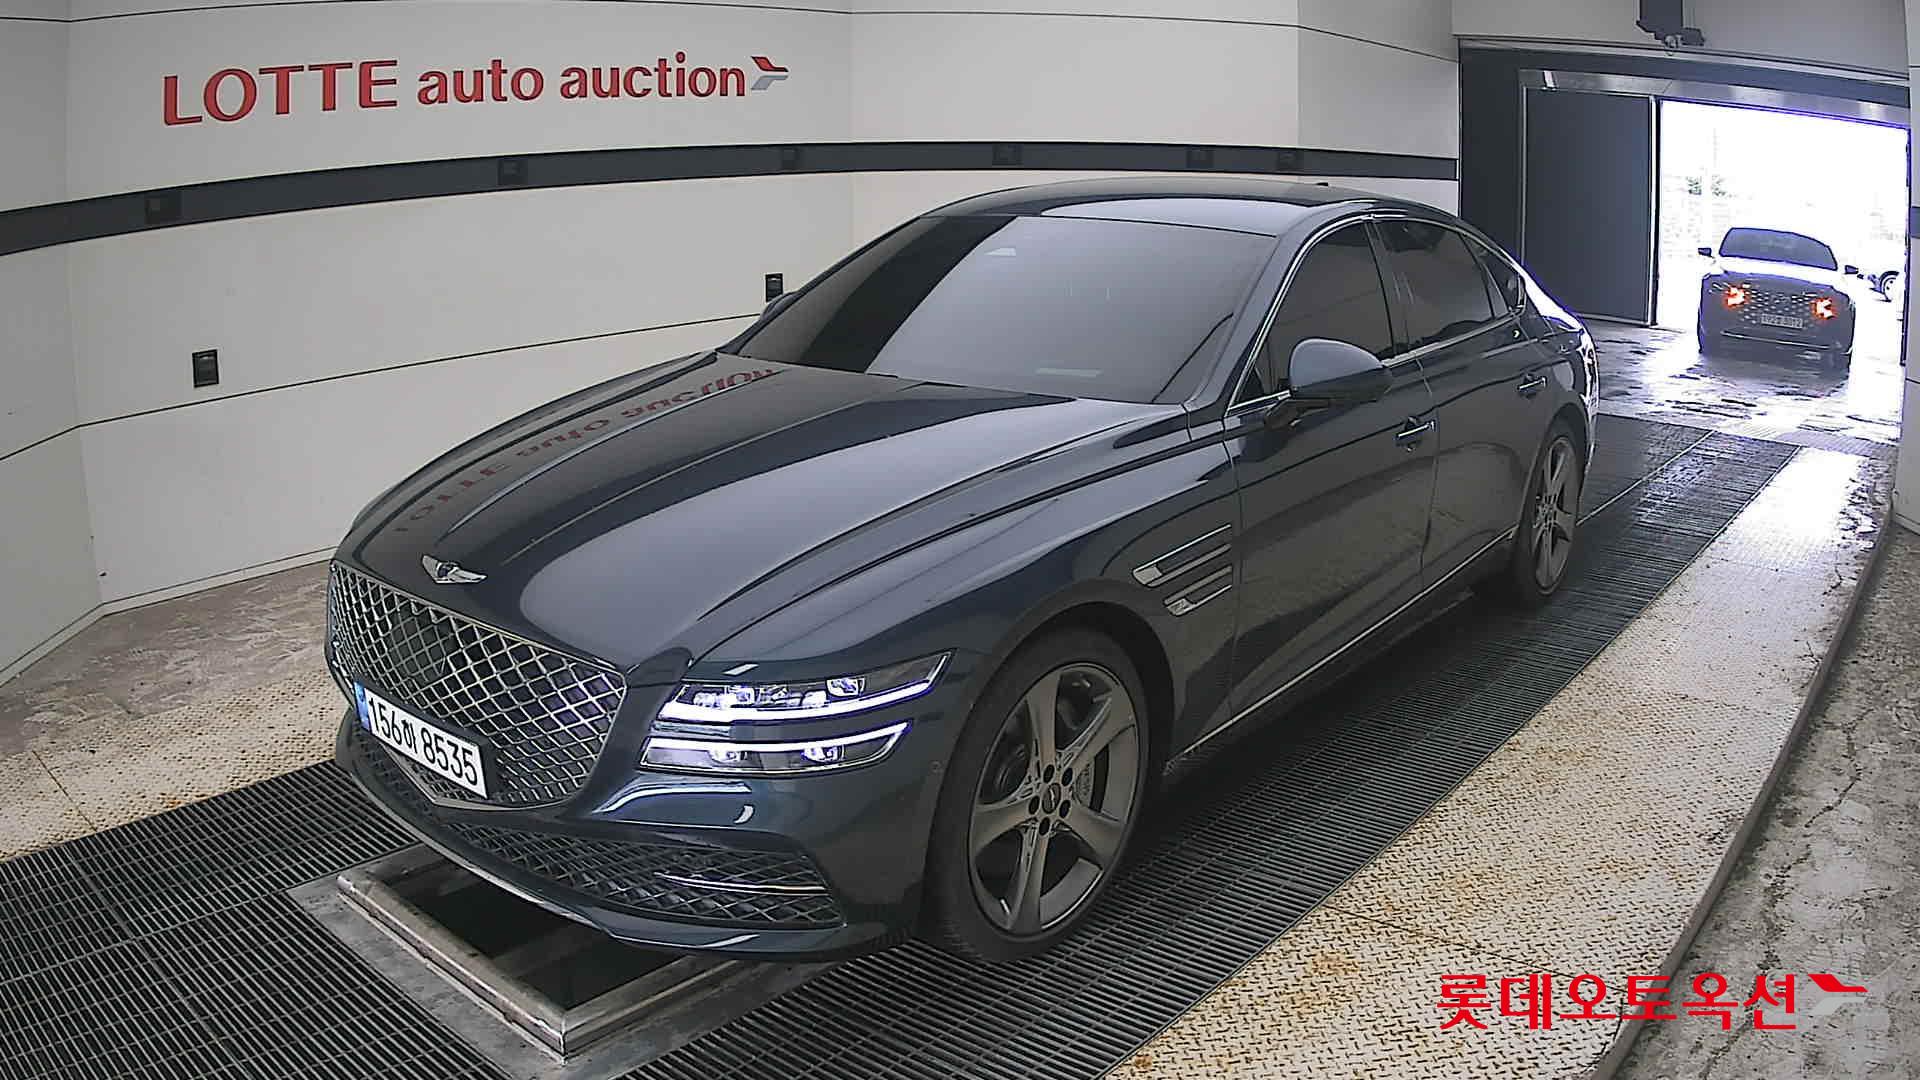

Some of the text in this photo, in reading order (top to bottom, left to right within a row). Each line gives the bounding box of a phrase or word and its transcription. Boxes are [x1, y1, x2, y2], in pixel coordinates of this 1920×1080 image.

[163, 52, 747, 126] LOTTE auto auction
[420, 727, 479, 787] 8535
